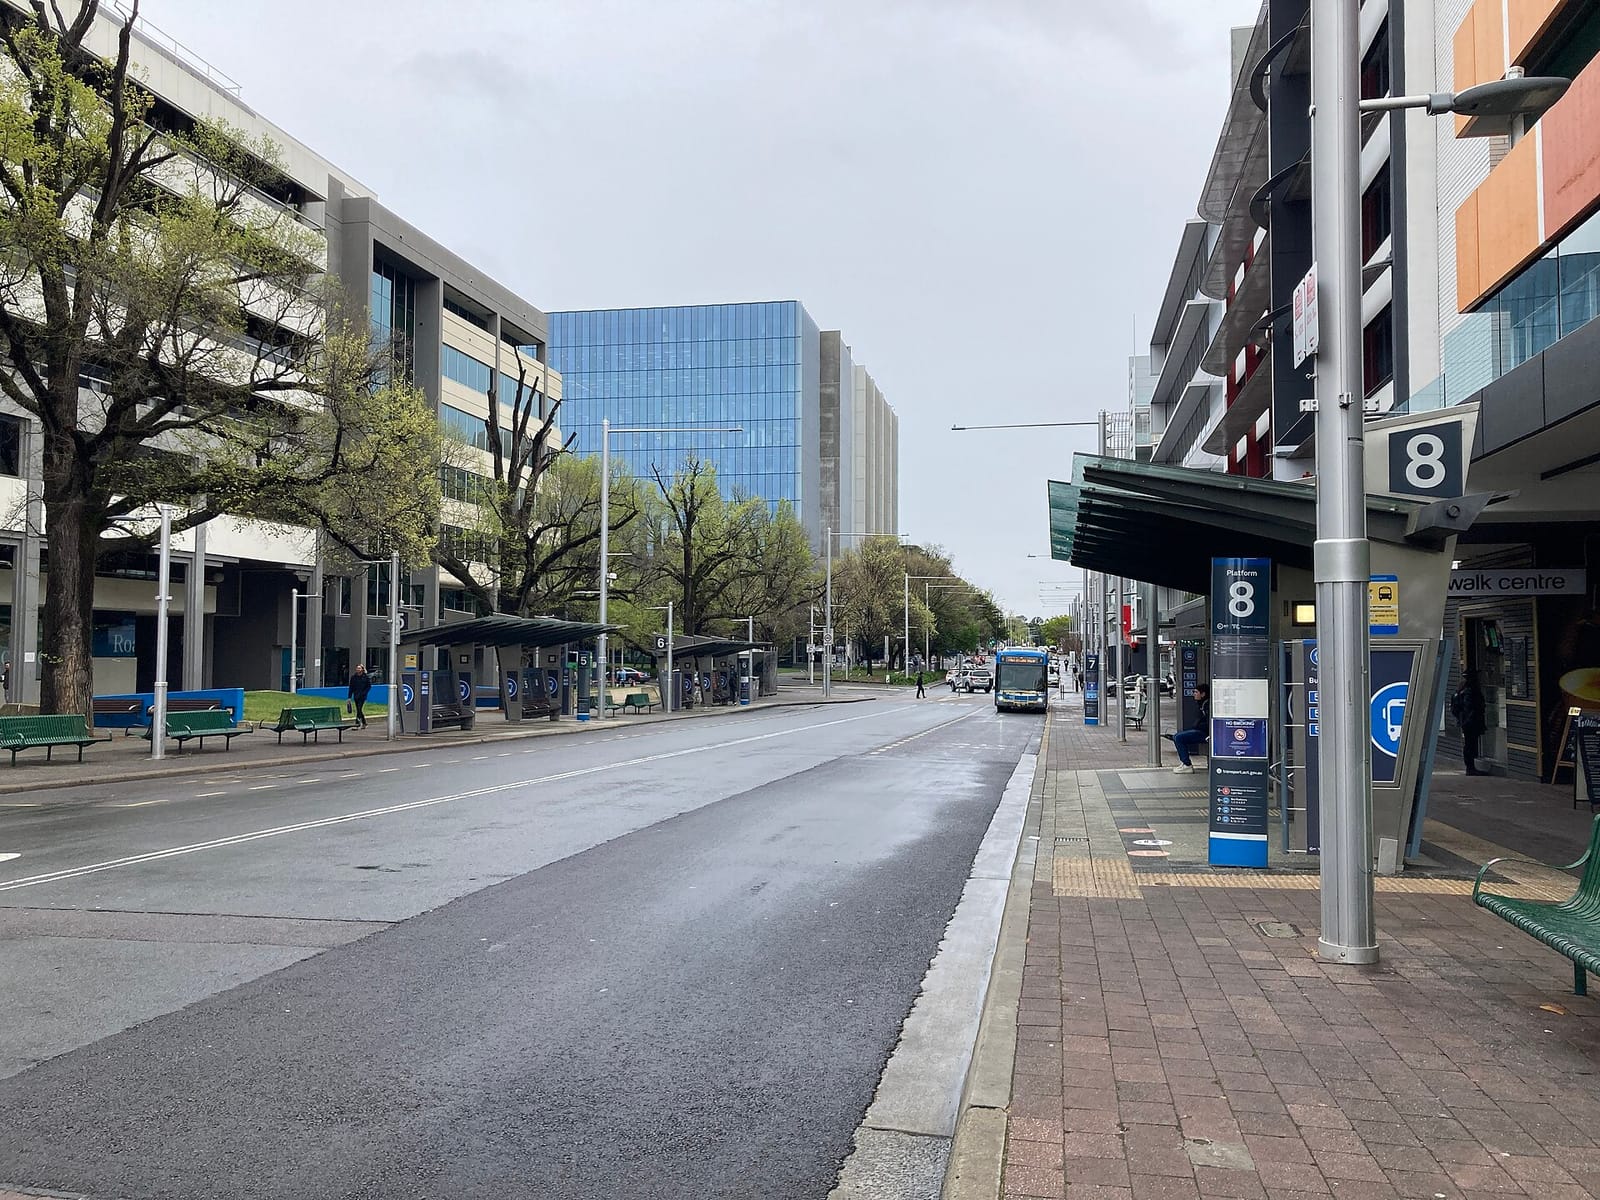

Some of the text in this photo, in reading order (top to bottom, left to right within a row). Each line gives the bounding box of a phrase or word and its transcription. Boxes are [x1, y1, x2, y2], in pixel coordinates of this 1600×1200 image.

[1405, 434, 1446, 488] 8
[1226, 569, 1258, 577] Platform
[1498, 574, 1566, 591] centre
[1228, 580, 1255, 618] 8
[657, 637, 665, 649] 6
[580, 656, 587, 666] 5
[1089, 660, 1095, 669] 7
